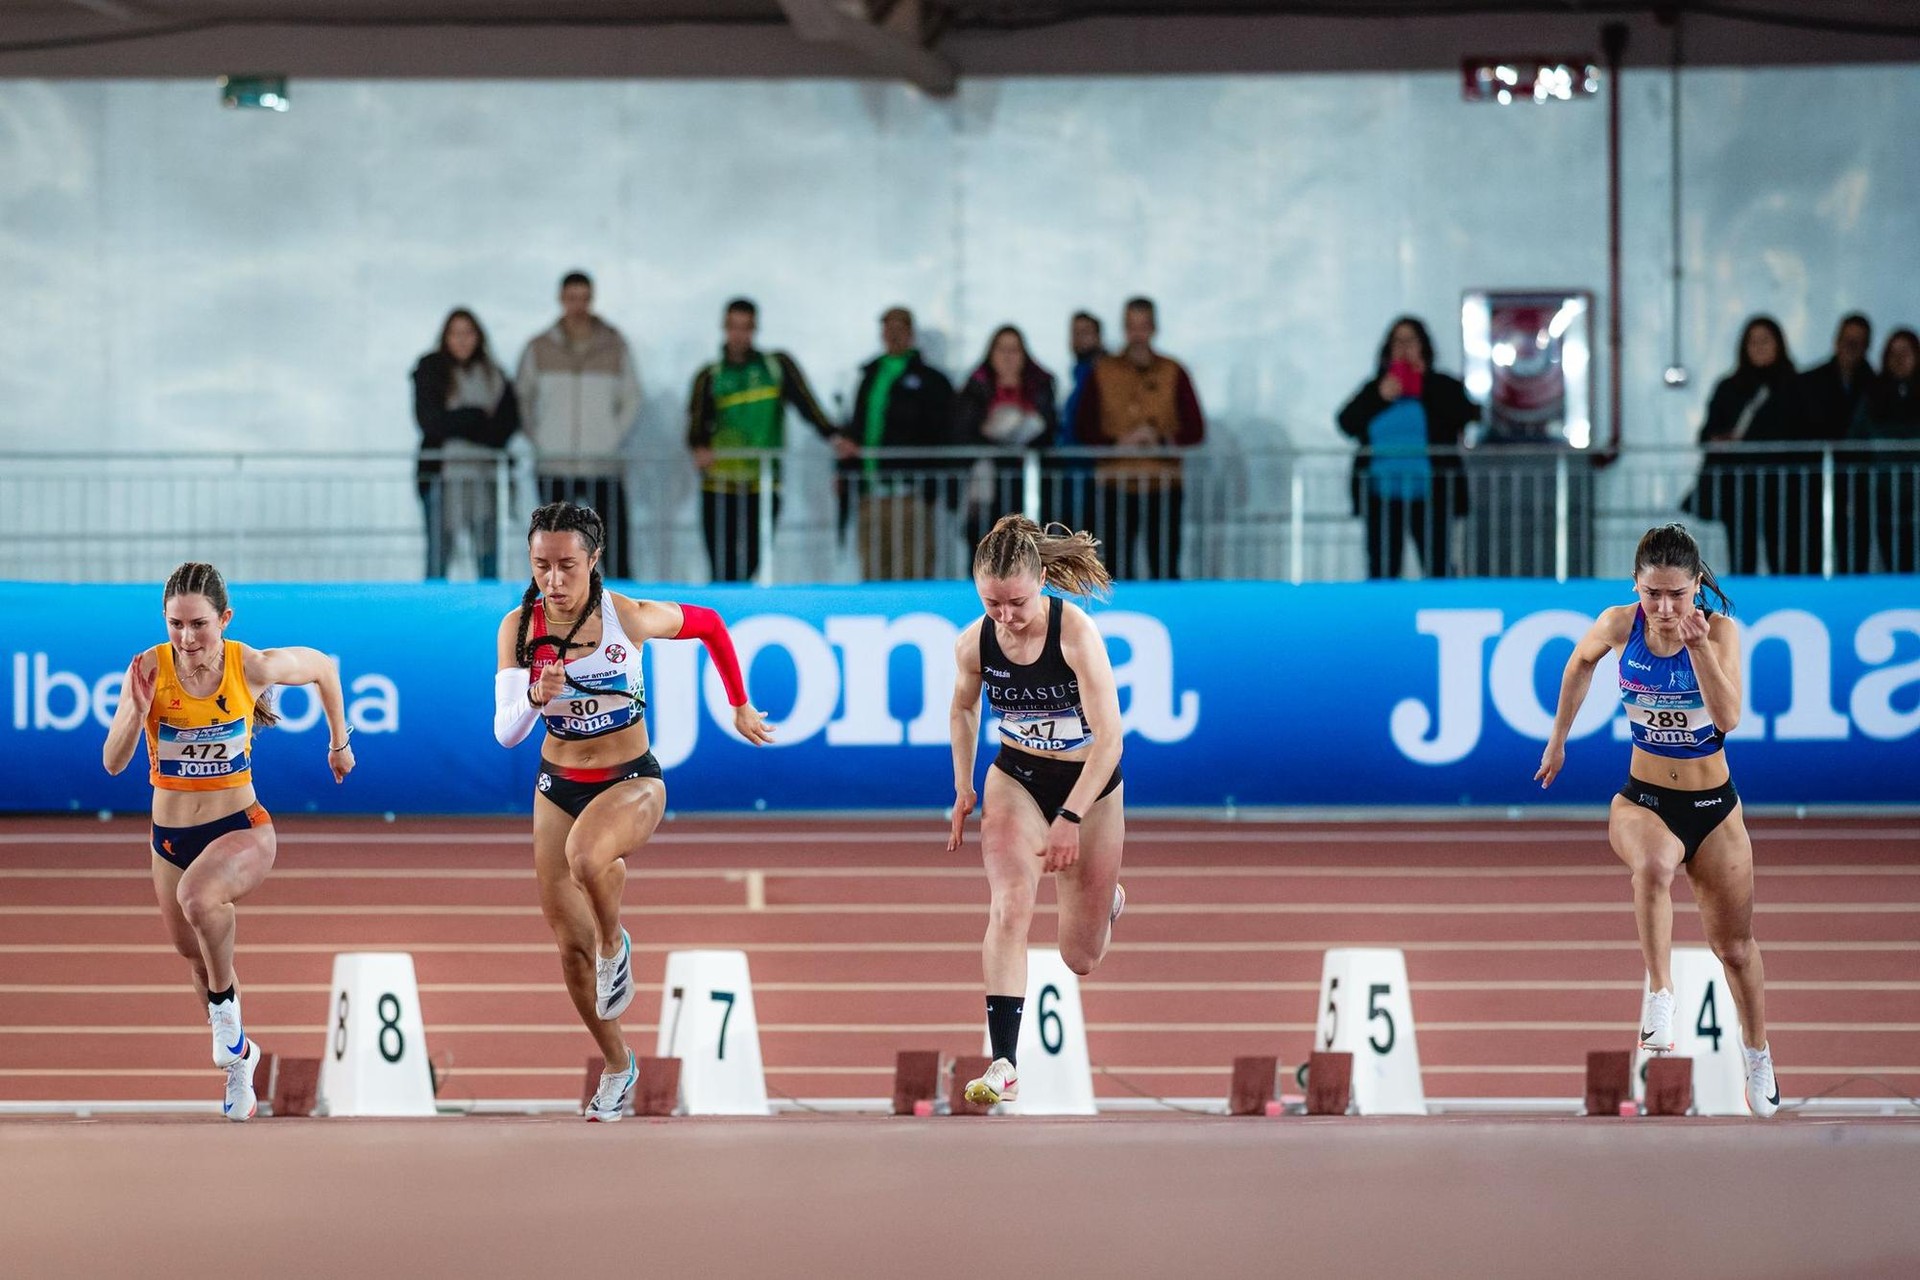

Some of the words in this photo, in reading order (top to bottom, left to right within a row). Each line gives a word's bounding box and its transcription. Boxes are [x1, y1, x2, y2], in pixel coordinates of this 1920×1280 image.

[13, 652, 399, 733] Ibeoa
[569, 699, 599, 716] 80
[591, 670, 618, 679] amara
[983, 680, 1079, 701] PEGASUS
[181, 743, 228, 760] 472
[1643, 710, 1688, 728] 289
[336, 991, 349, 1061] 8
[377, 992, 405, 1062] 8
[711, 991, 735, 1060] 7
[1037, 984, 1064, 1055] 6
[1324, 977, 1339, 1048] 5
[1367, 984, 1396, 1055] 5
[1696, 979, 1722, 1052] 4
